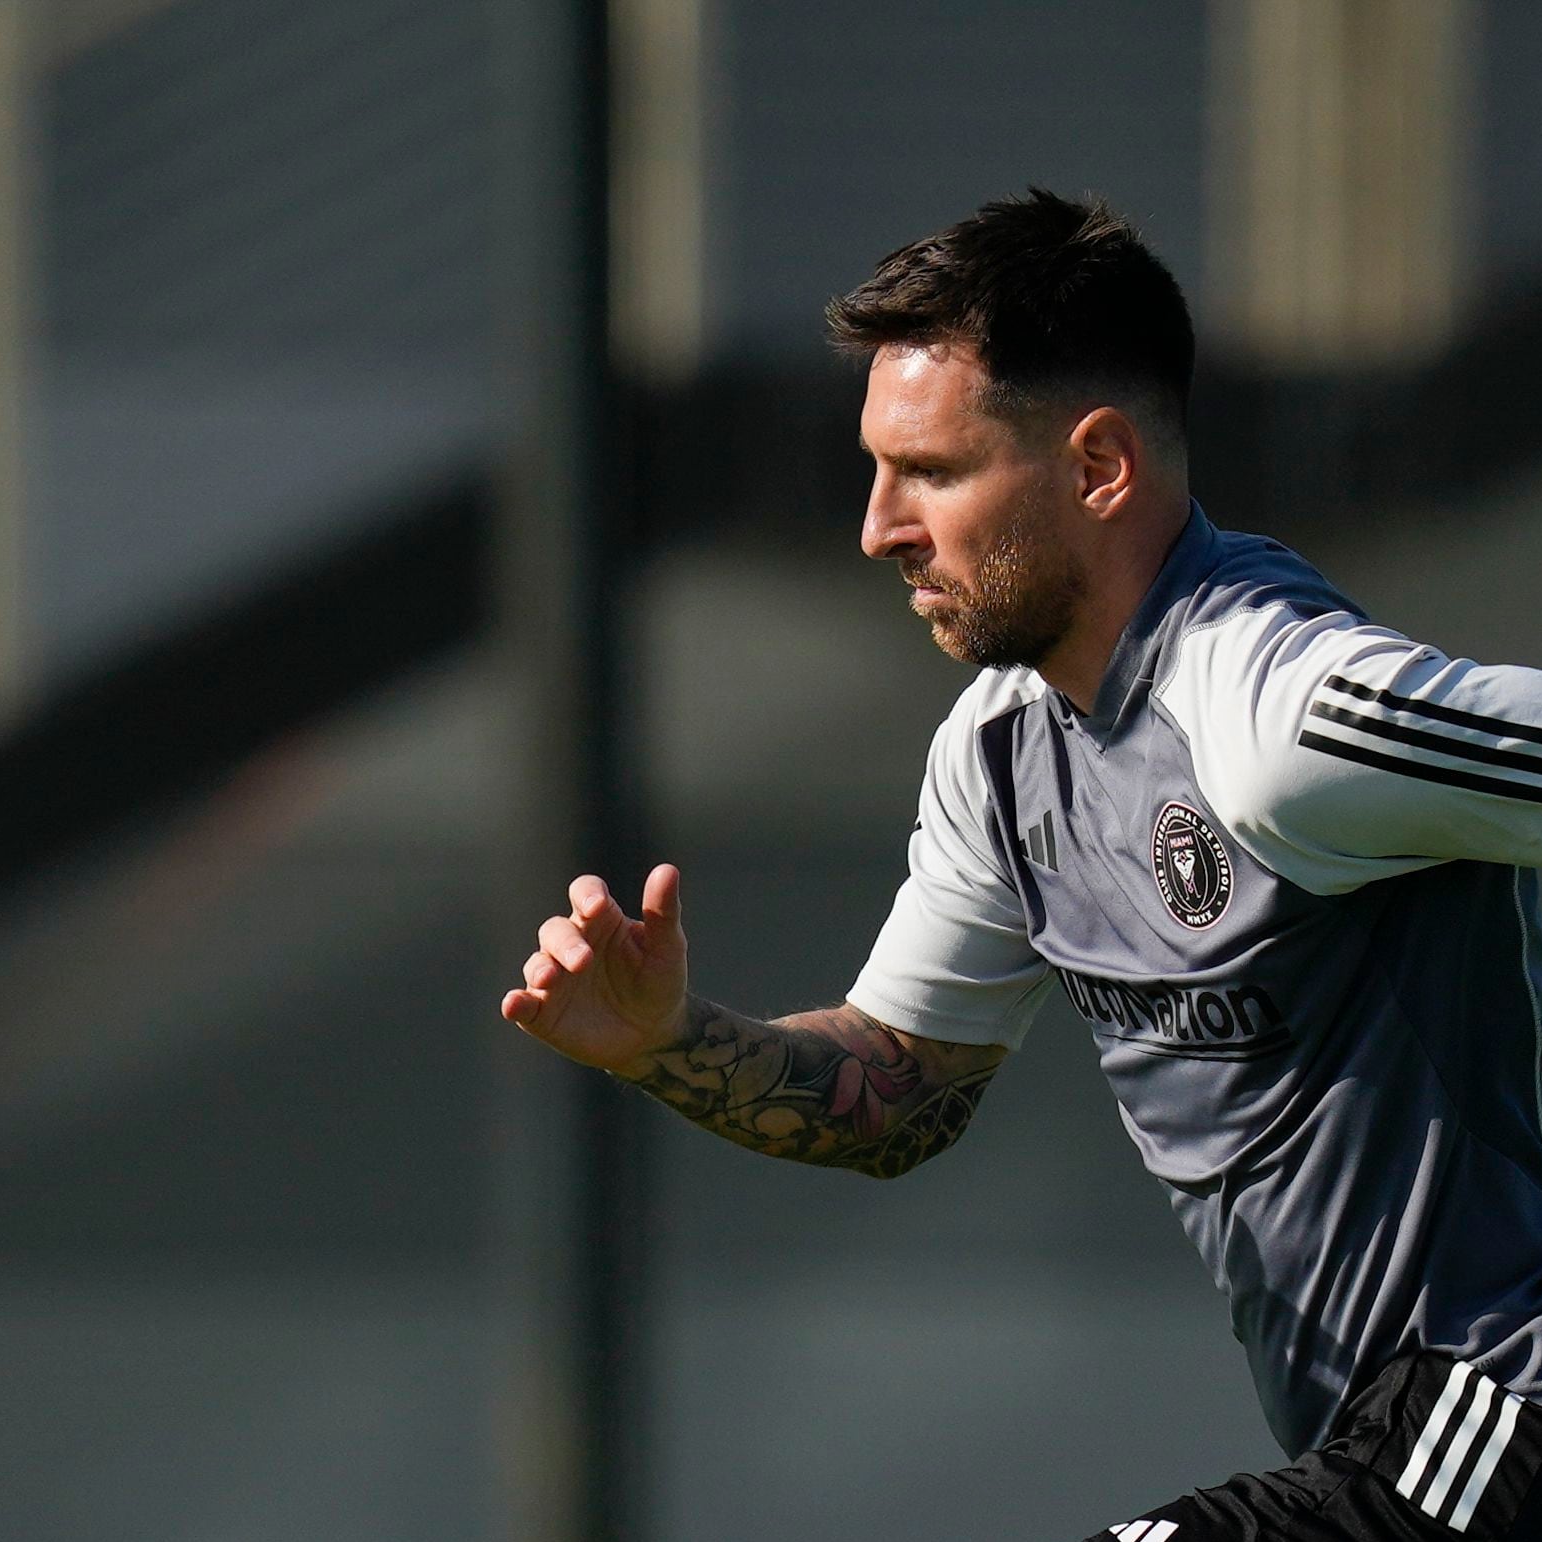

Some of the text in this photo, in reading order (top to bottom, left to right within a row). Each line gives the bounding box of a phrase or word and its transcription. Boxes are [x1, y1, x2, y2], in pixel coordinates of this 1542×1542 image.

[1158, 870, 1172, 903] CLUB
[1200, 824, 1214, 841] DE
[1055, 966, 1283, 1042] utoNation
